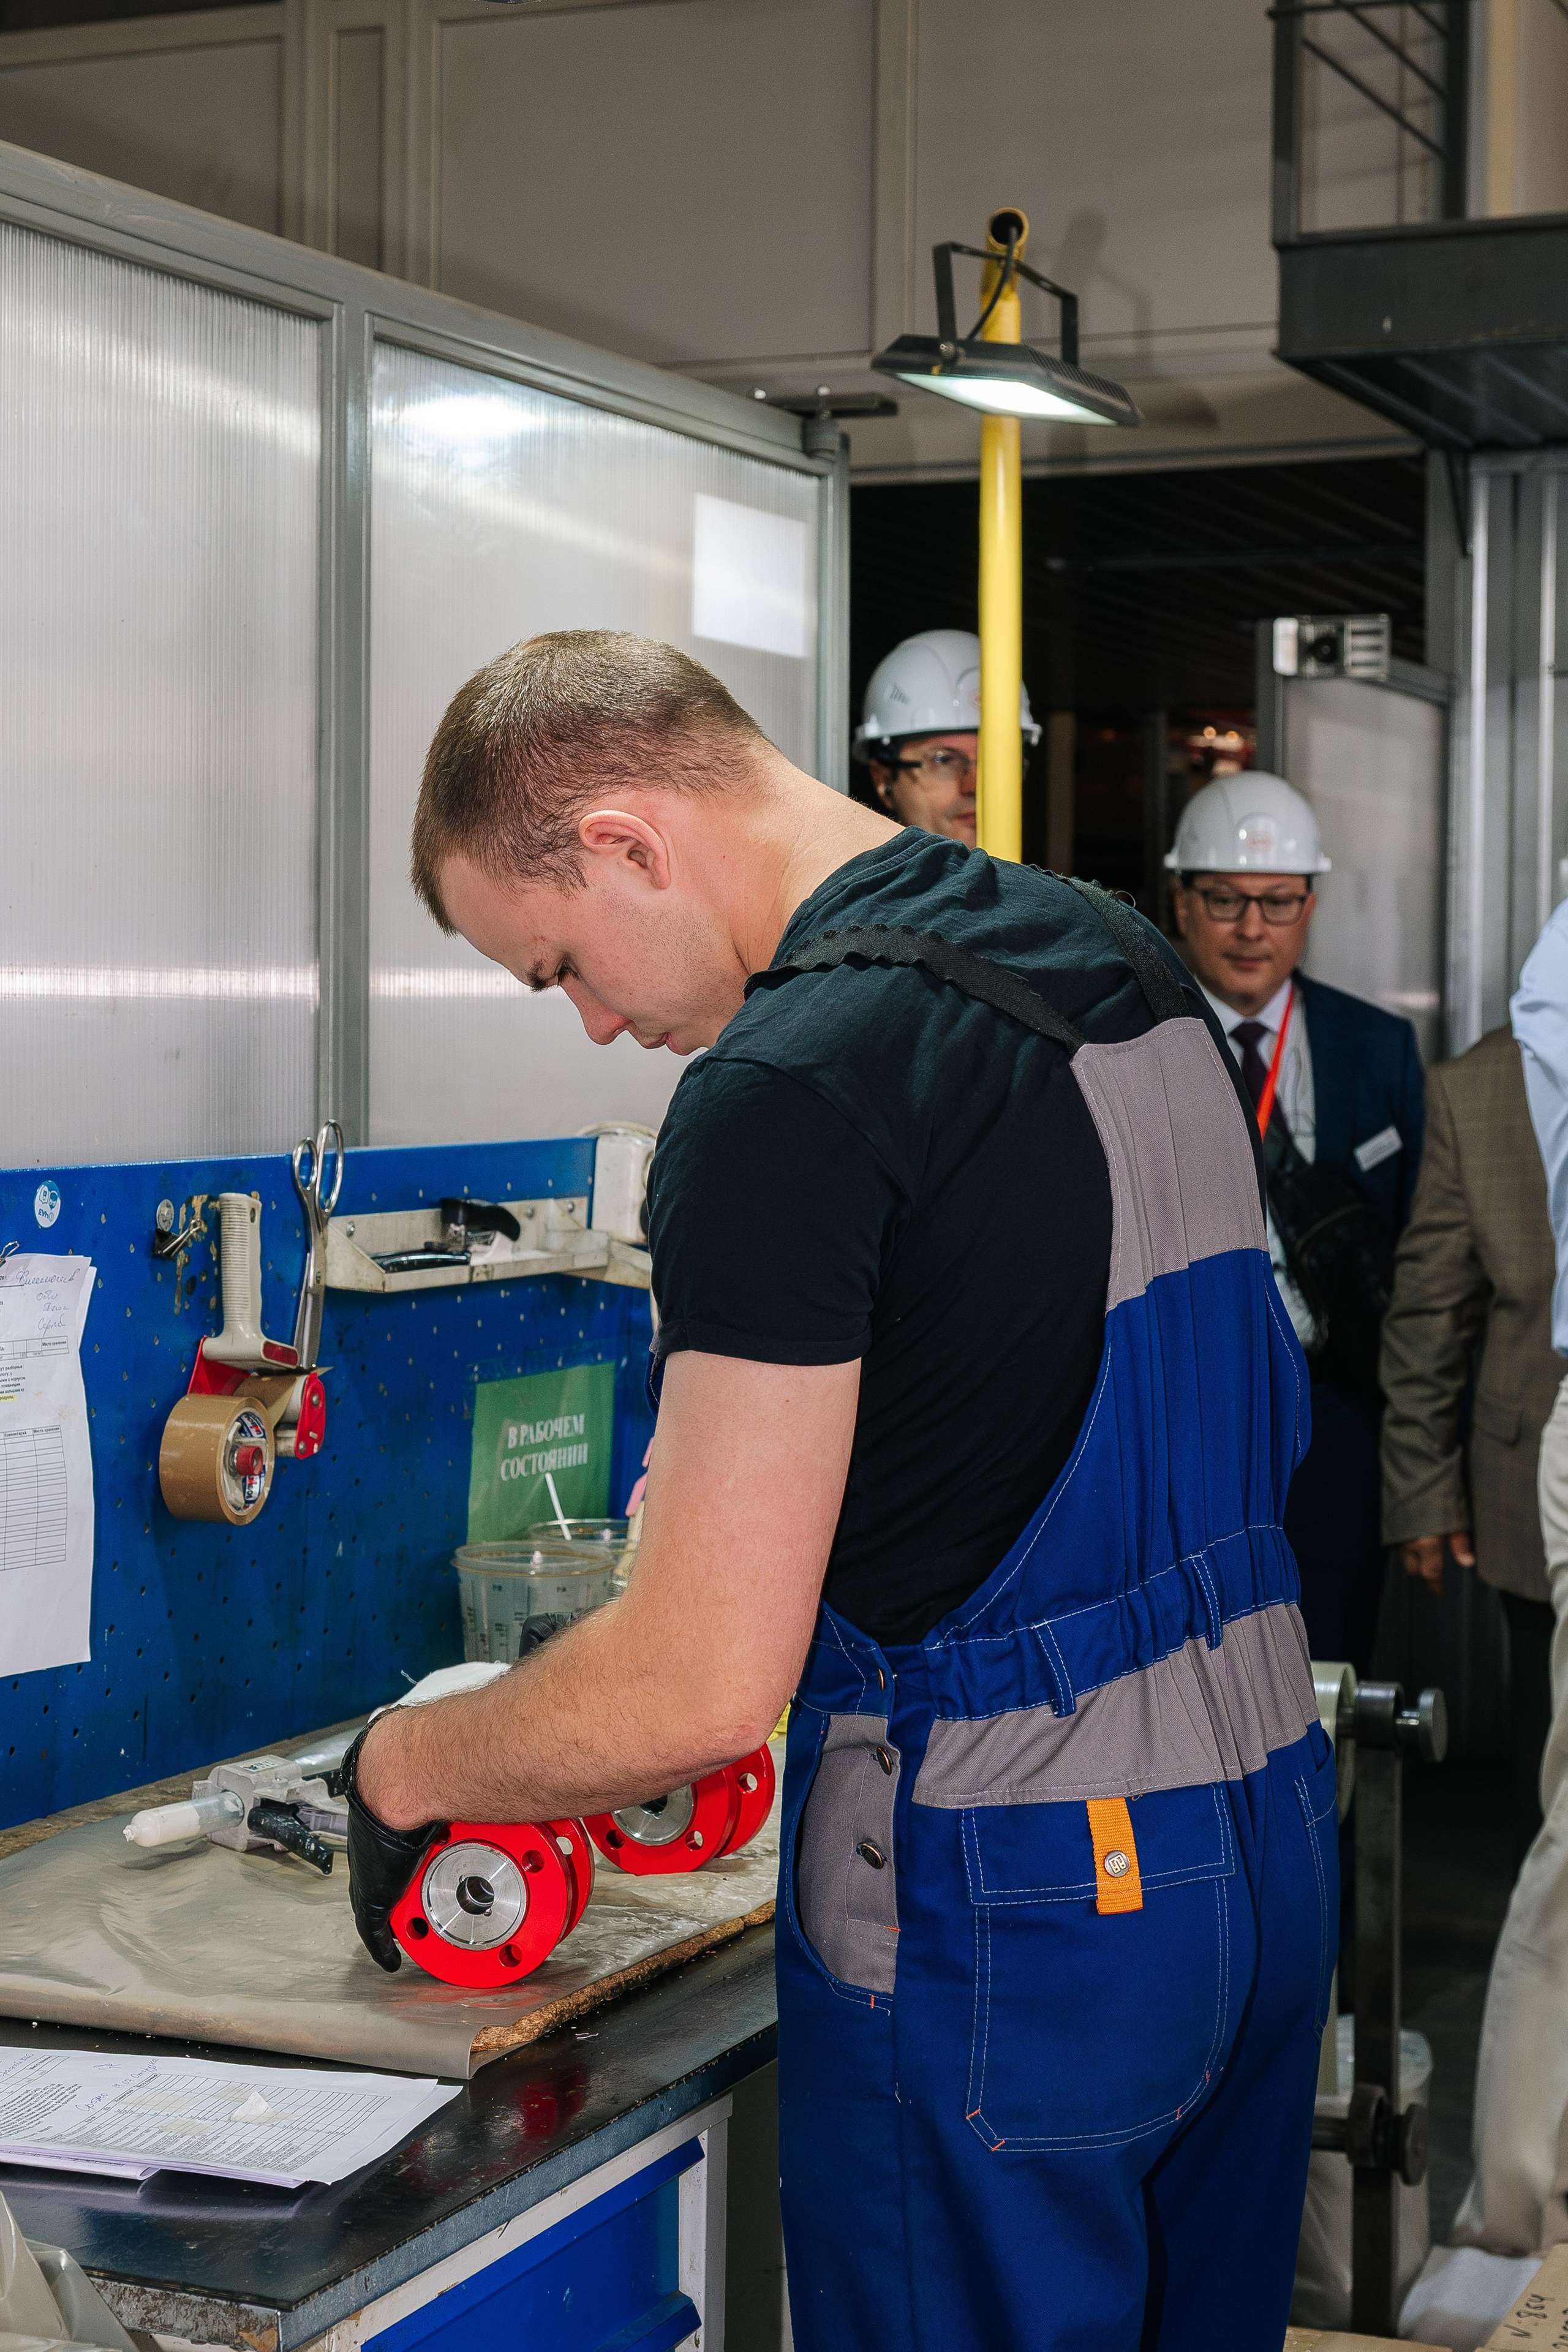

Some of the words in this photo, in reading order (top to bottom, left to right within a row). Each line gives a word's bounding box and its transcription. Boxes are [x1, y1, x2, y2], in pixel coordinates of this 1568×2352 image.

[508, 1426, 518, 1449] В
[520, 1413, 585, 1446] РАБОЧЕМ
[500, 1442, 589, 1482] СОСТОЯНИИ
